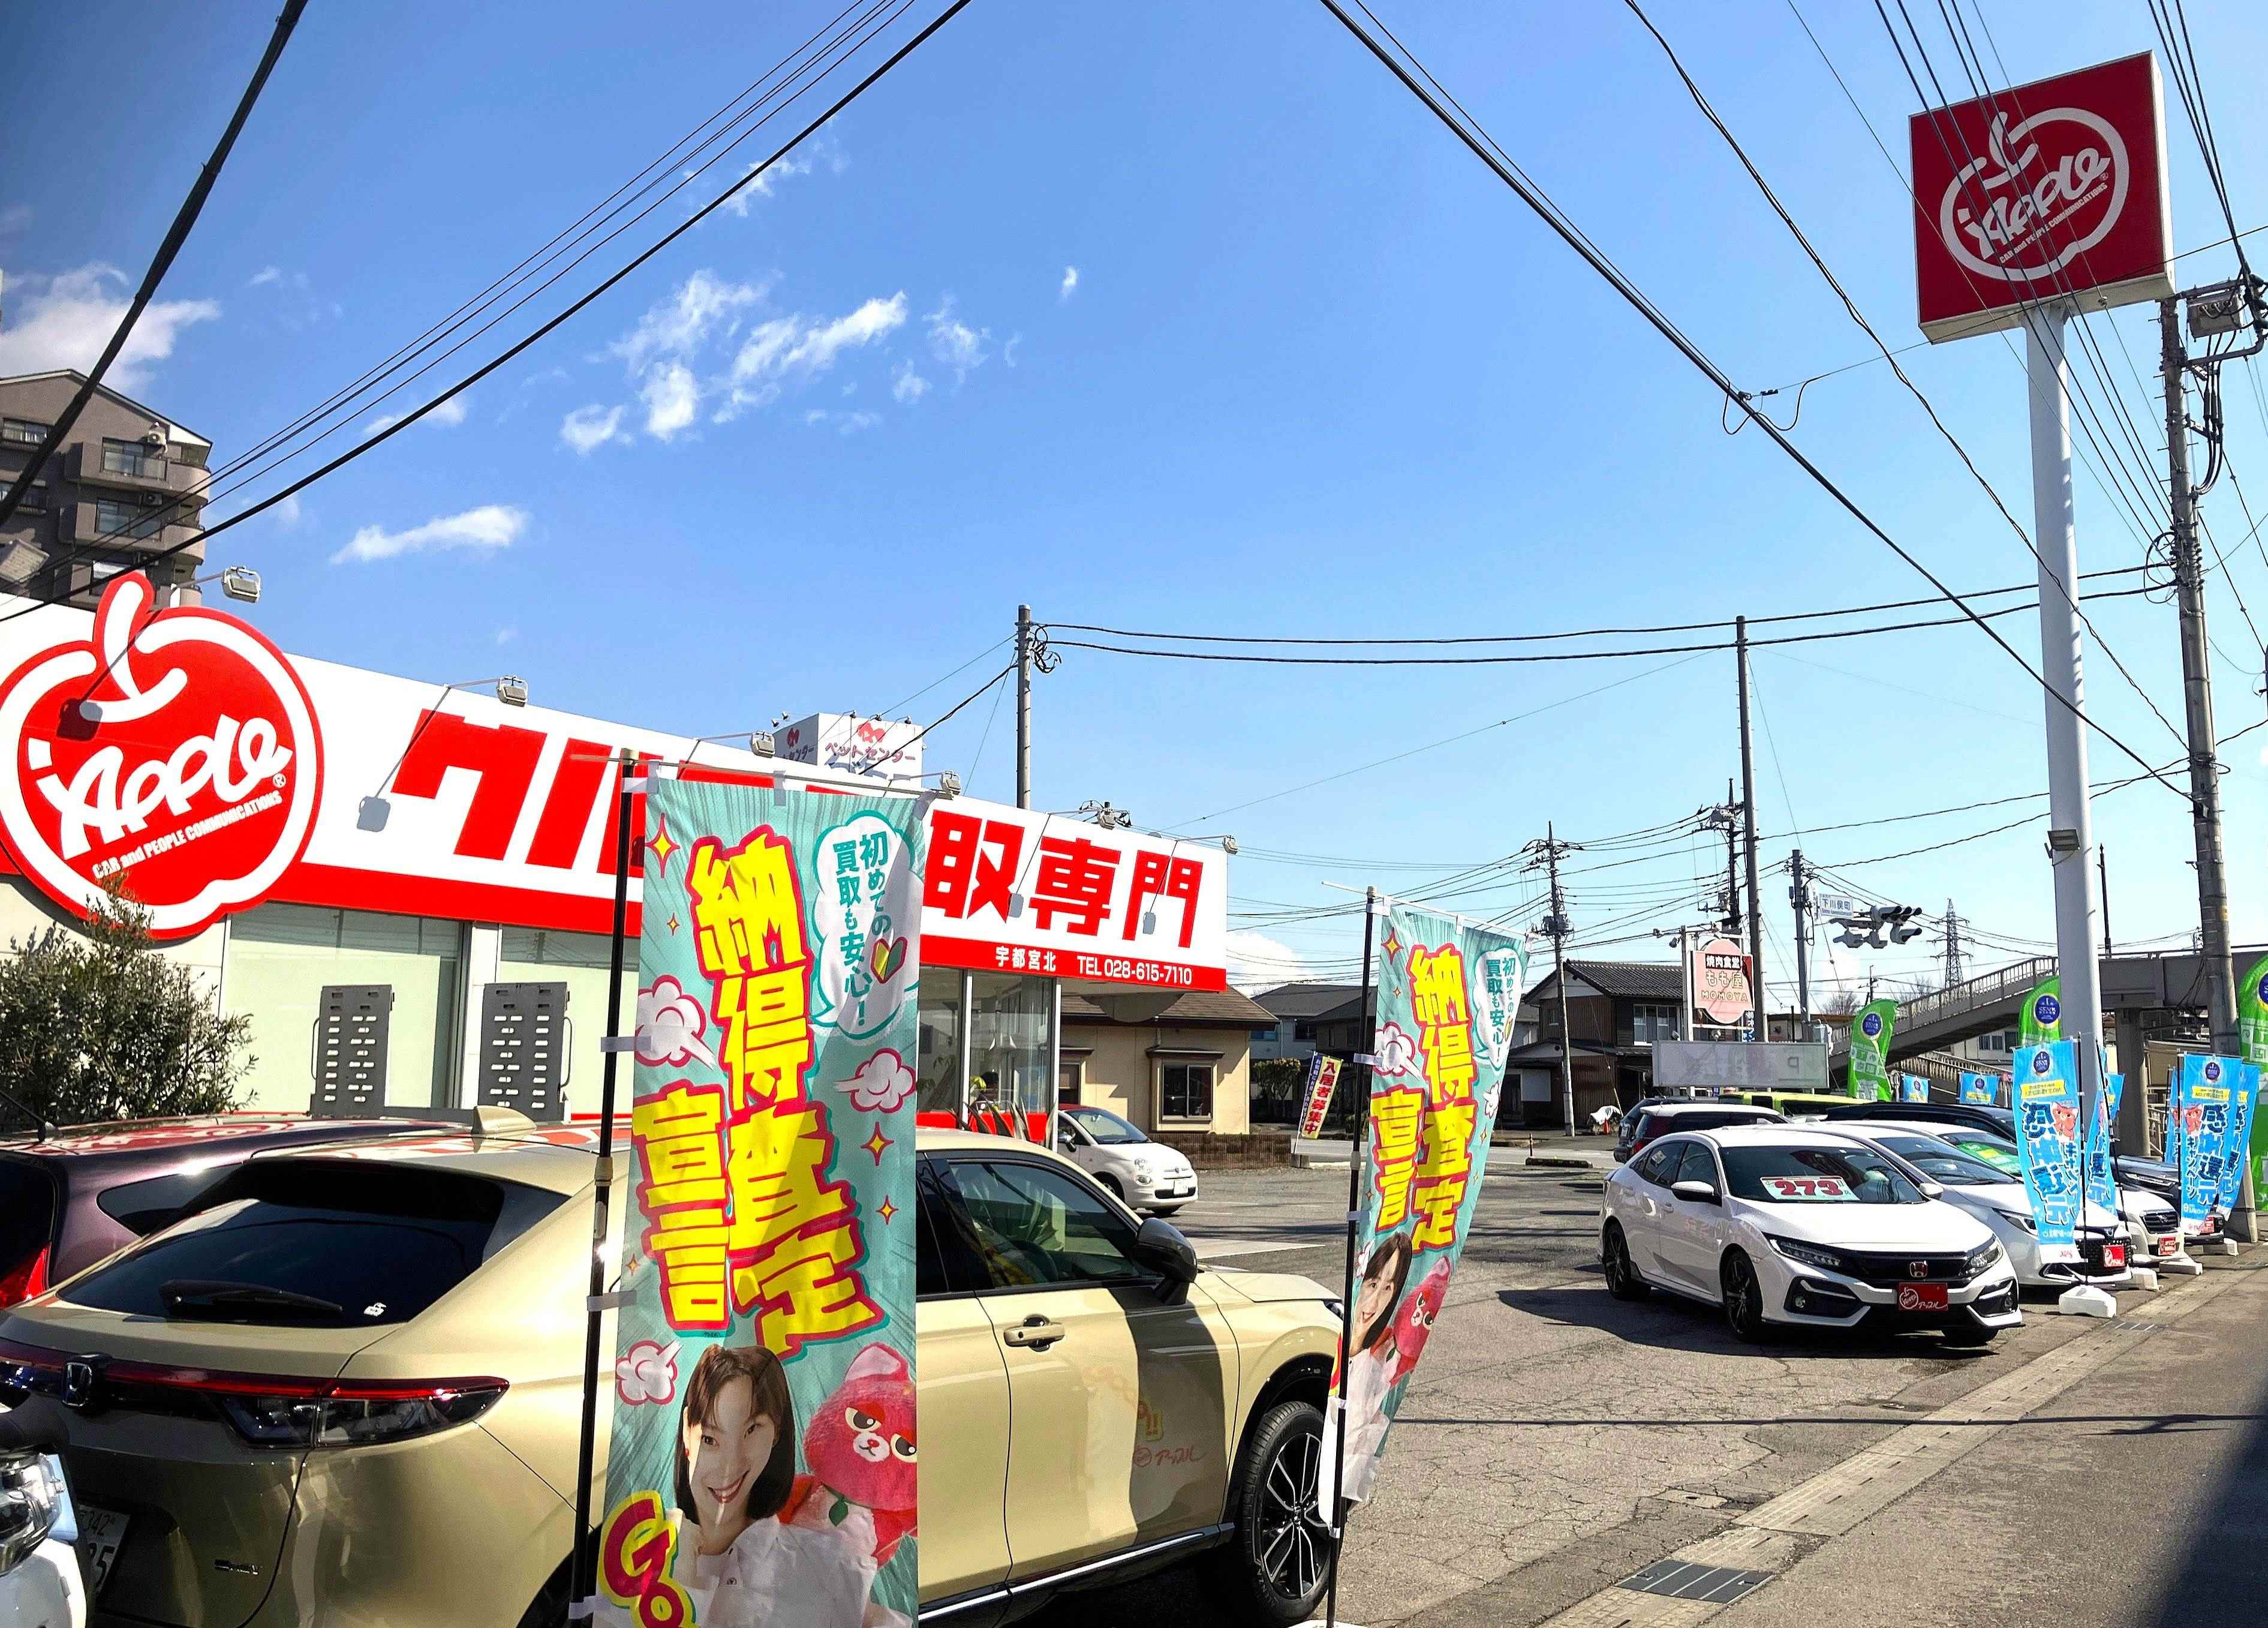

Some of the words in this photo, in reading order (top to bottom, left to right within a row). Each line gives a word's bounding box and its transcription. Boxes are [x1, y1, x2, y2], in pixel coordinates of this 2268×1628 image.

[1957, 146, 2111, 260] Apple
[2048, 182, 2108, 227] COMMUNICATIONS
[33, 714, 293, 860] Apple
[92, 857, 122, 879] CAR
[120, 846, 147, 869] and
[143, 829, 188, 858] PEOPLE
[185, 789, 283, 841] COMMUNICATIONS
[859, 833, 891, 933] 初めての
[995, 946, 1057, 972] 宇都宮北
[1076, 955, 1102, 977] TEL
[1104, 958, 1192, 986] 028-615-7110
[1502, 957, 1515, 1013] 初めての
[1701, 990, 1748, 1002] MOMOYA
[1705, 969, 1743, 989] もも屋
[690, 830, 877, 1356] 納得査定
[1412, 948, 1473, 1252] 納得査定
[631, 1086, 728, 1326] 宣言
[1371, 1094, 1424, 1231] 宣言
[1774, 1180, 1843, 1196] 273
